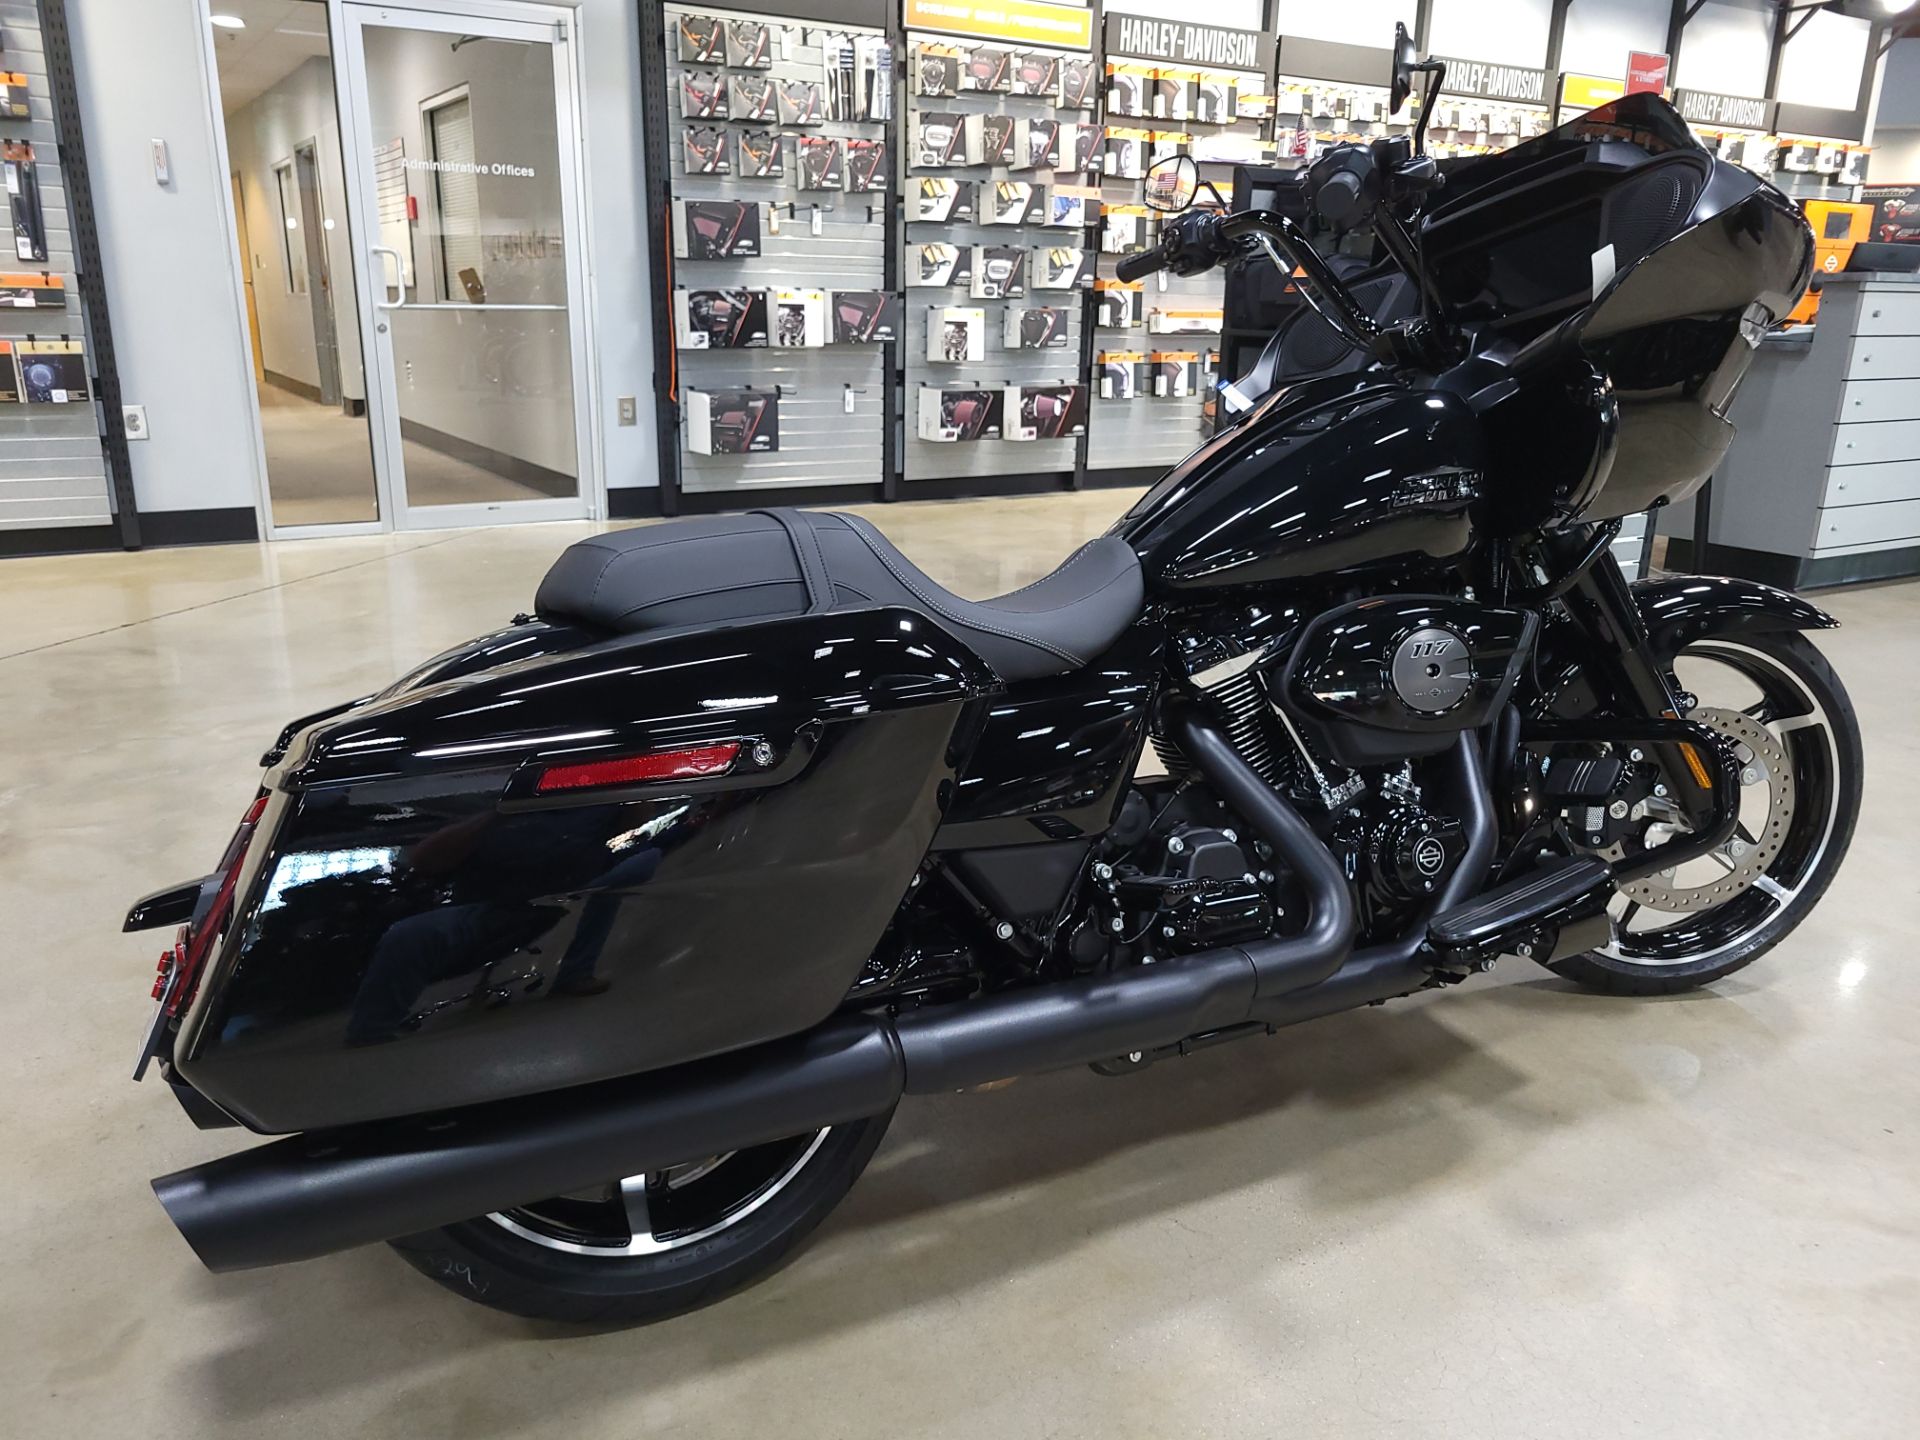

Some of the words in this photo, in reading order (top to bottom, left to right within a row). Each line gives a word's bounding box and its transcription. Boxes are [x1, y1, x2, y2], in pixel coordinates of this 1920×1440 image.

[1119, 17, 1259, 67] HARLEY-DAVIDSON
[1440, 60, 1545, 101] HARLEY-DAVIDSON
[1682, 91, 1767, 127] HARLEY-DAVIDSON
[401, 158, 488, 175] Administrative
[491, 163, 535, 178] Offices
[1410, 638, 1454, 659] 117
